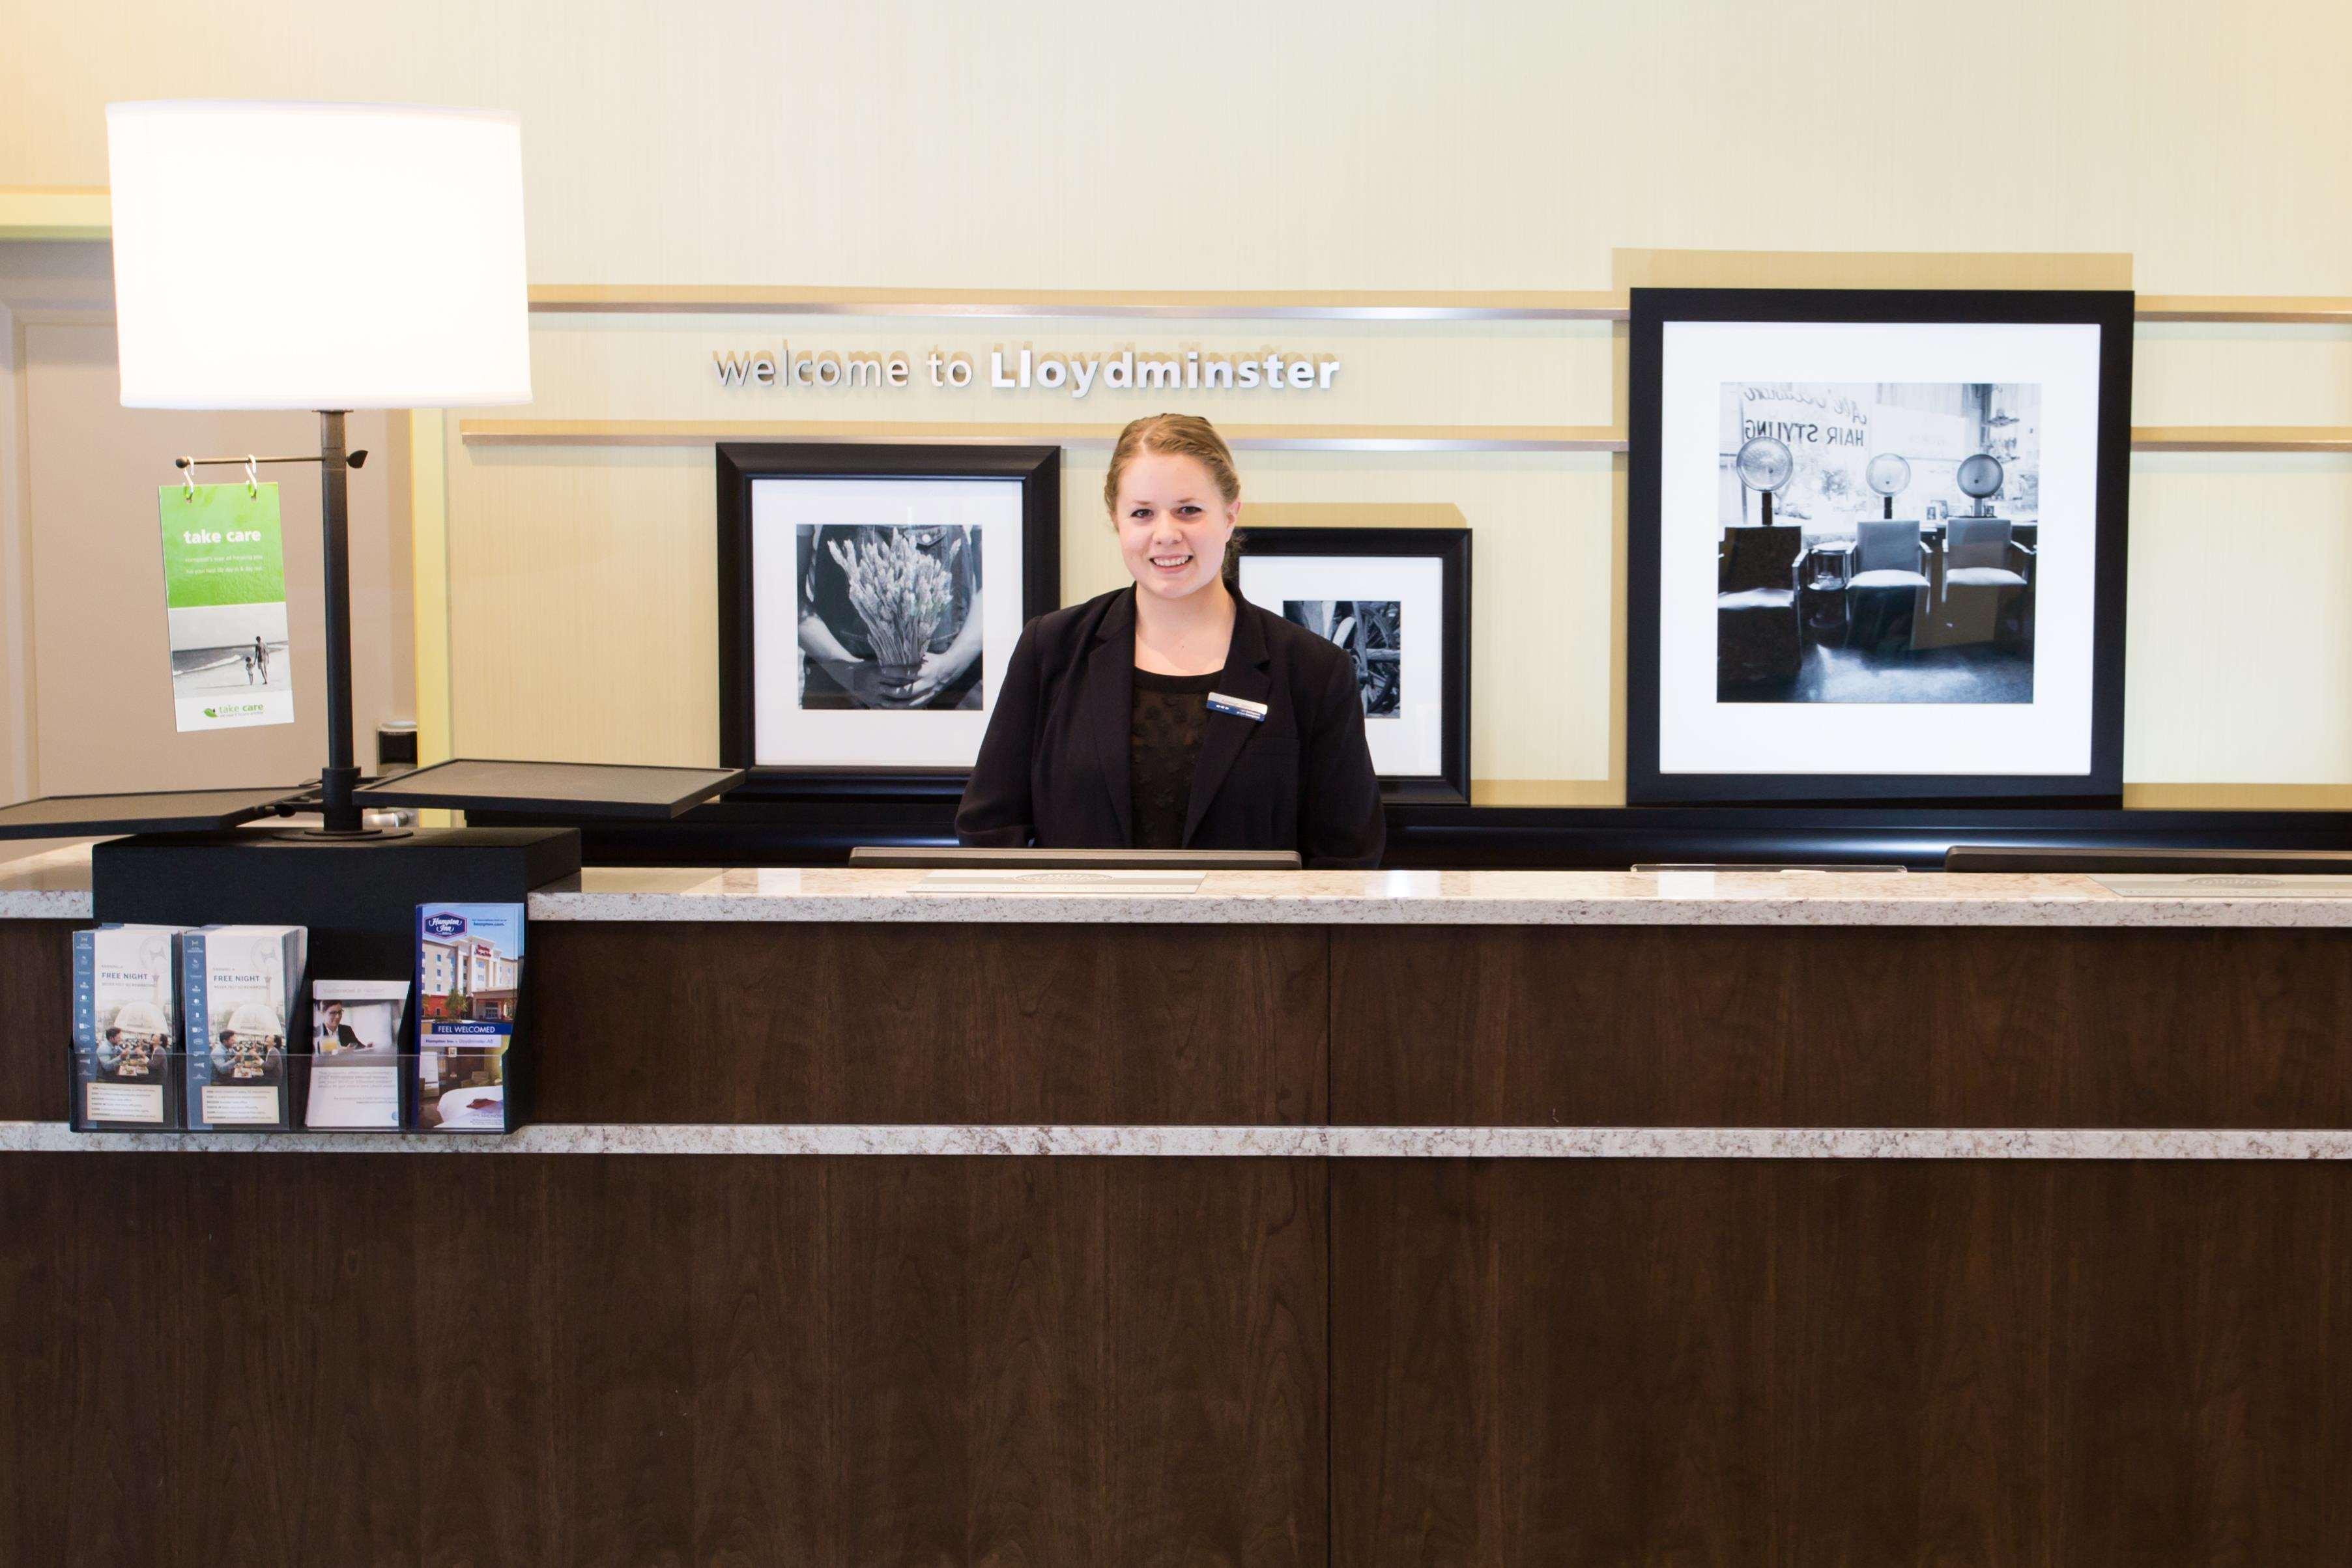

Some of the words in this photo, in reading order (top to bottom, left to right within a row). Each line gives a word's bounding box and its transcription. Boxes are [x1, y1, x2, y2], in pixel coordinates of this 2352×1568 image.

[715, 347, 910, 388] welcome
[926, 352, 973, 388] to
[991, 349, 1340, 399] Lloydminster
[183, 529, 222, 544] take
[226, 530, 262, 542] care
[219, 704, 239, 714] take
[242, 703, 264, 712] care
[438, 1025, 453, 1034] FEEL
[454, 1025, 496, 1034] WELCOMED
